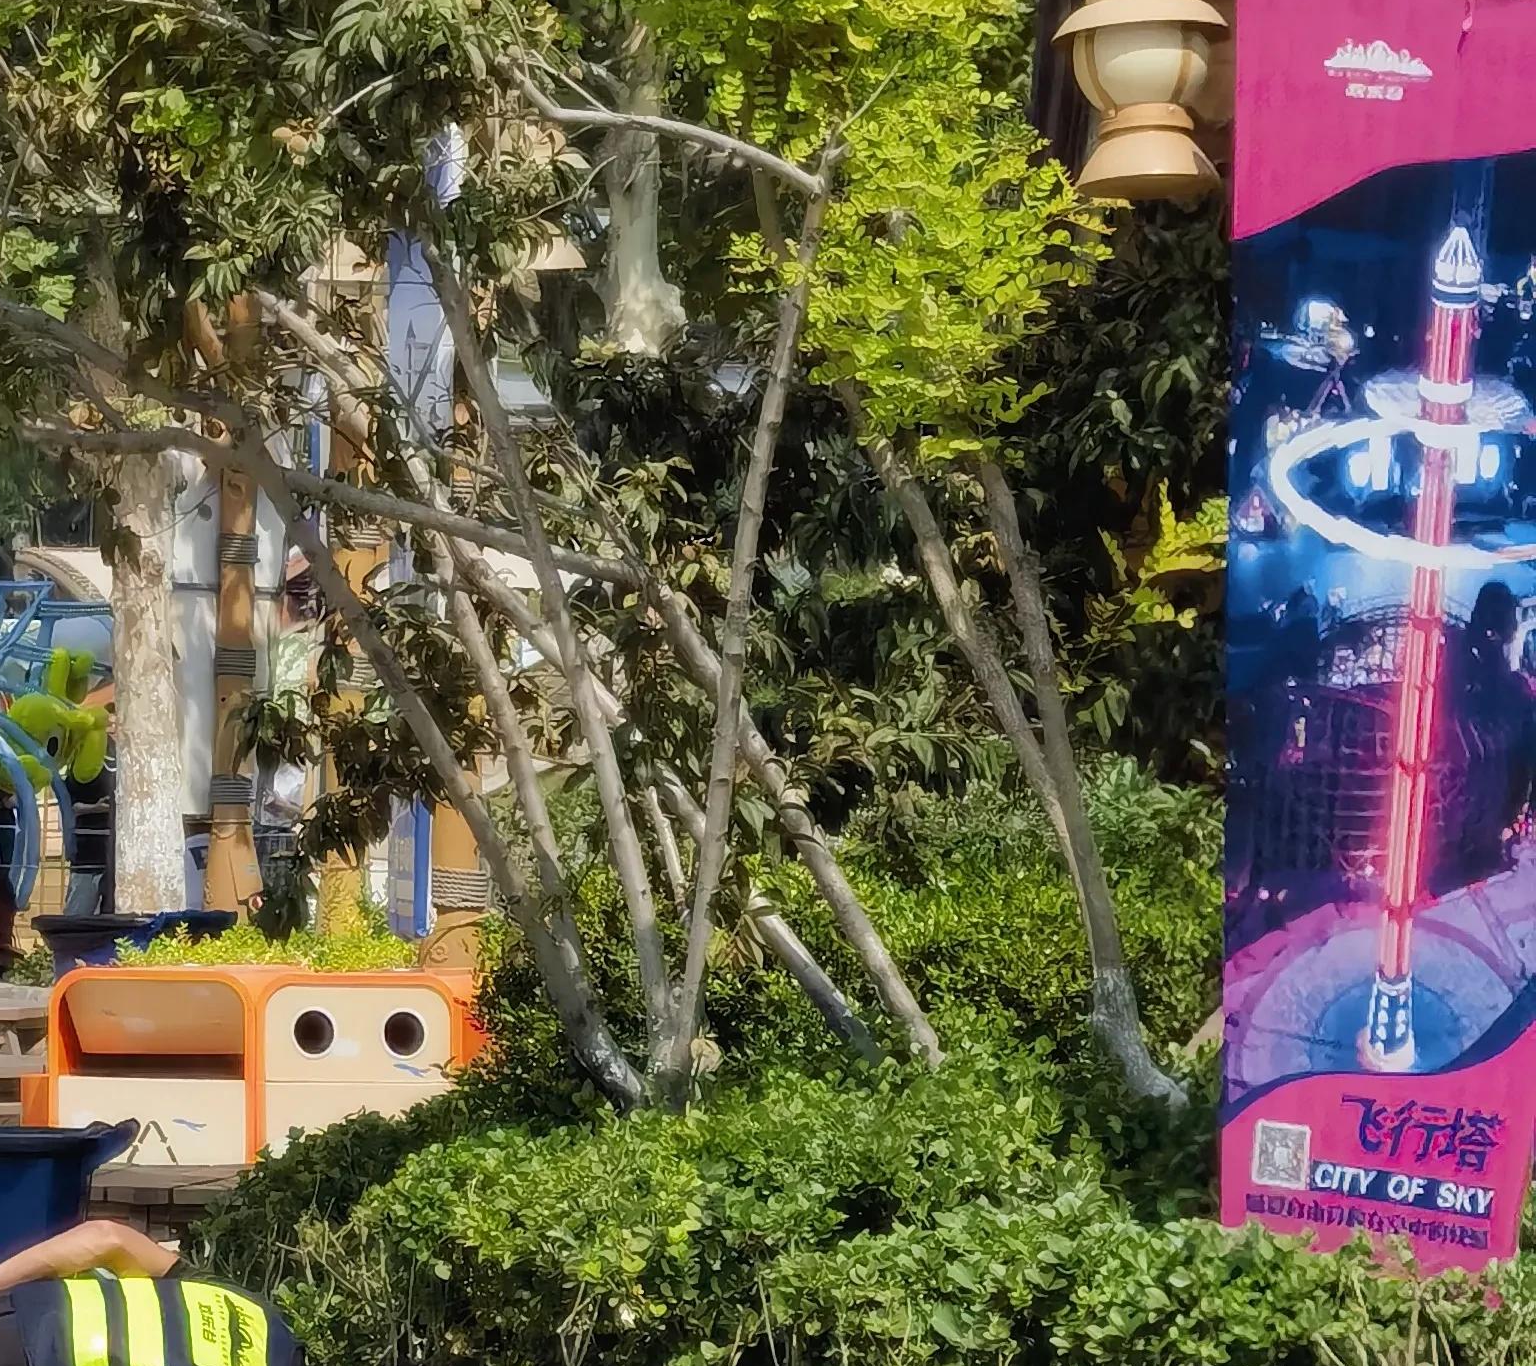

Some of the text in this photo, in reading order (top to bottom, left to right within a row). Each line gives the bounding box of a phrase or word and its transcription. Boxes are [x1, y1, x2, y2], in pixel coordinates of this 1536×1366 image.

[1341, 1094, 1500, 1171] 飞行塔
[1314, 1161, 1494, 1215] CITY OF SKY
